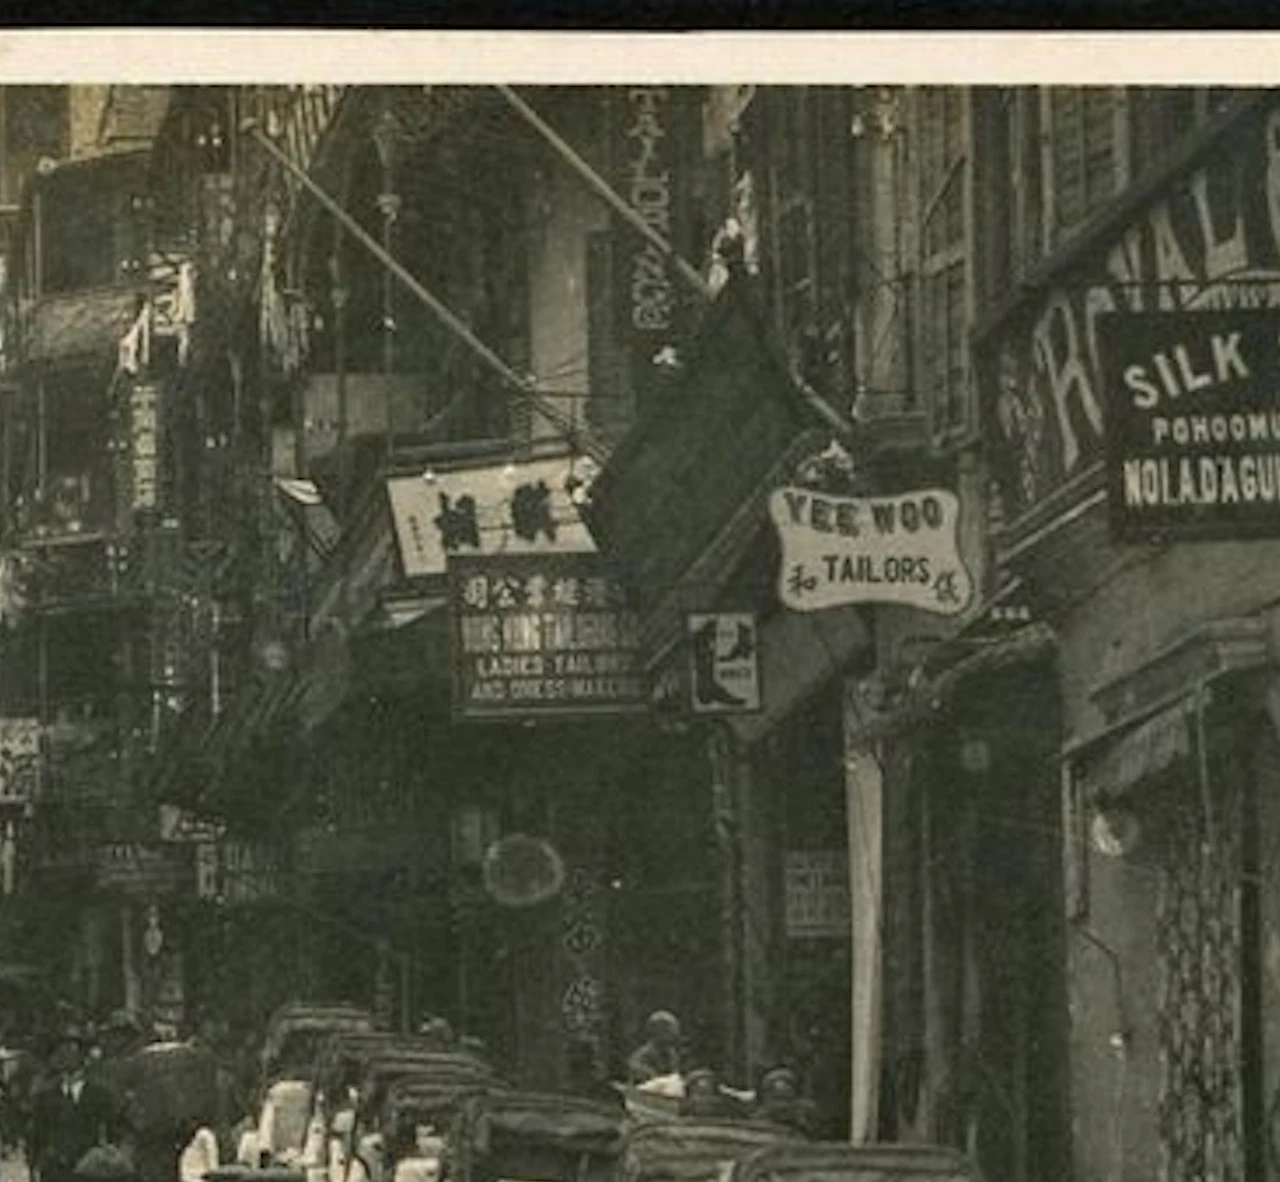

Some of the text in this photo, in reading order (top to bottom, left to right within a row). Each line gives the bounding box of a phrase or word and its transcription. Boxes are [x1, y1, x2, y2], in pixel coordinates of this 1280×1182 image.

[1123, 331, 1250, 409] SILK
[782, 491, 944, 539] YEE WOO
[822, 554, 931, 584] TAILORS
